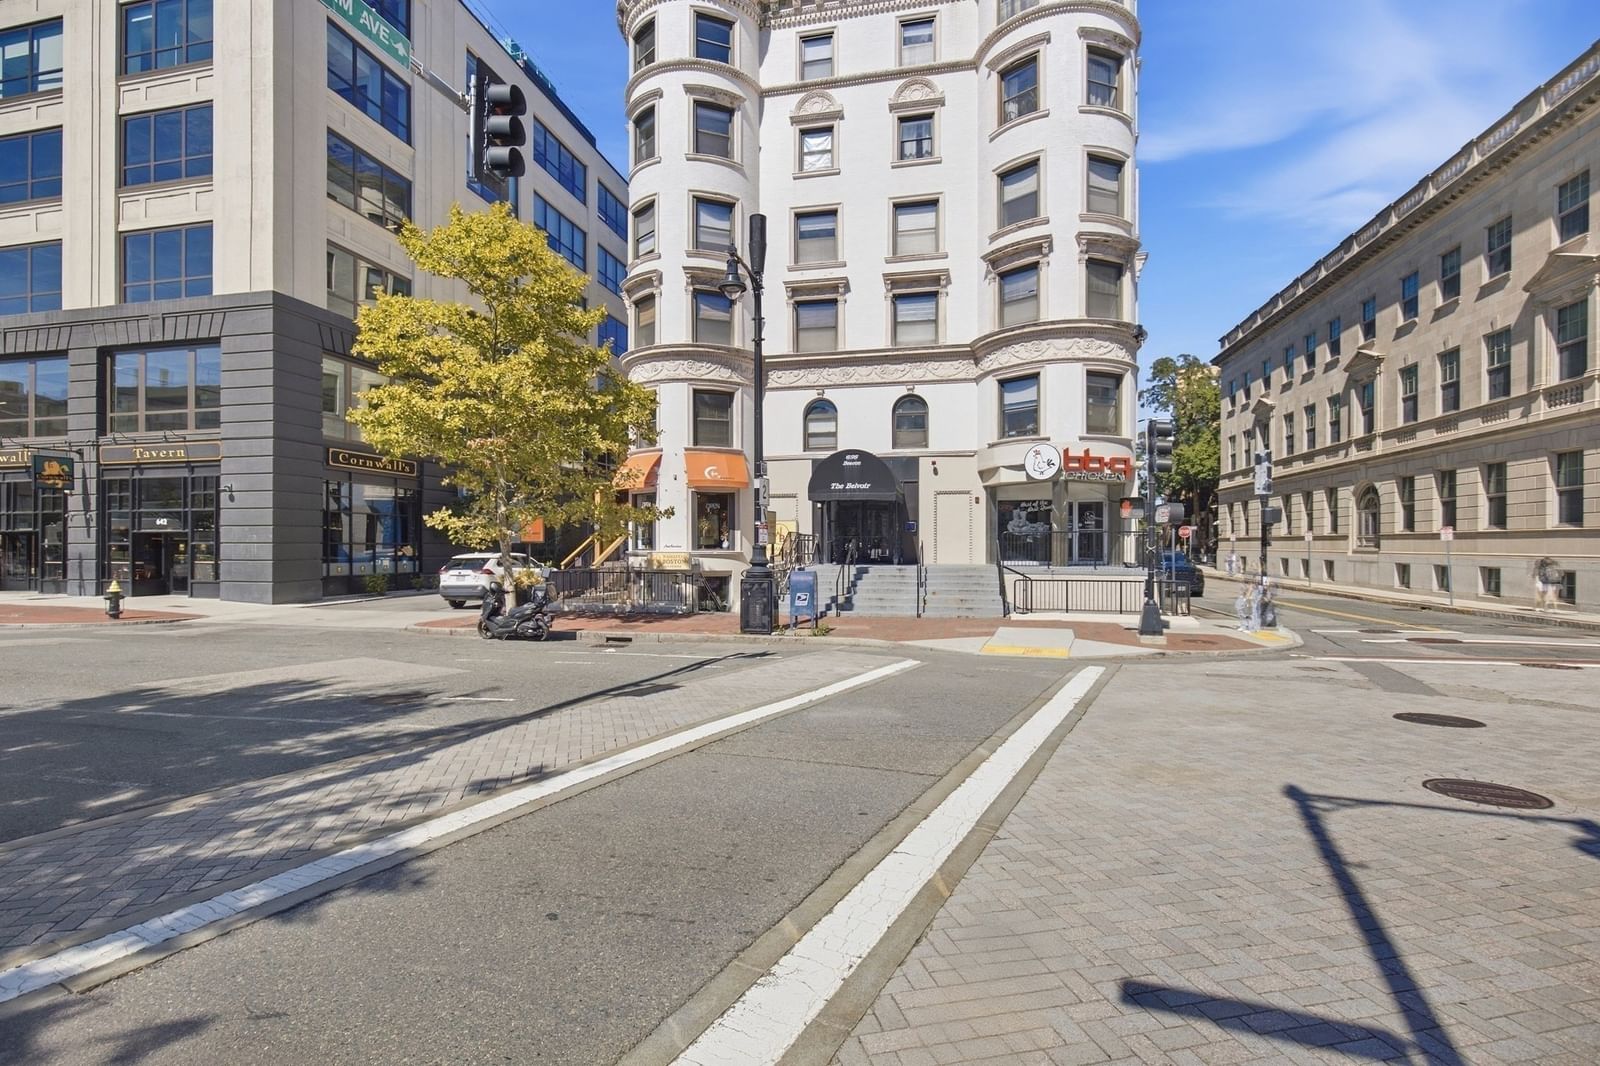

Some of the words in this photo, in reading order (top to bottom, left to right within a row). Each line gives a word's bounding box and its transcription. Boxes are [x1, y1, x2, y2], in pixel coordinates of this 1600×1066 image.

[360, 10, 390, 45] AVE
[133, 447, 185, 459] Tavern
[339, 453, 411, 473] Cornwall's
[1065, 471, 1126, 481] CHICKEN
[762, 484, 768, 499] 2
